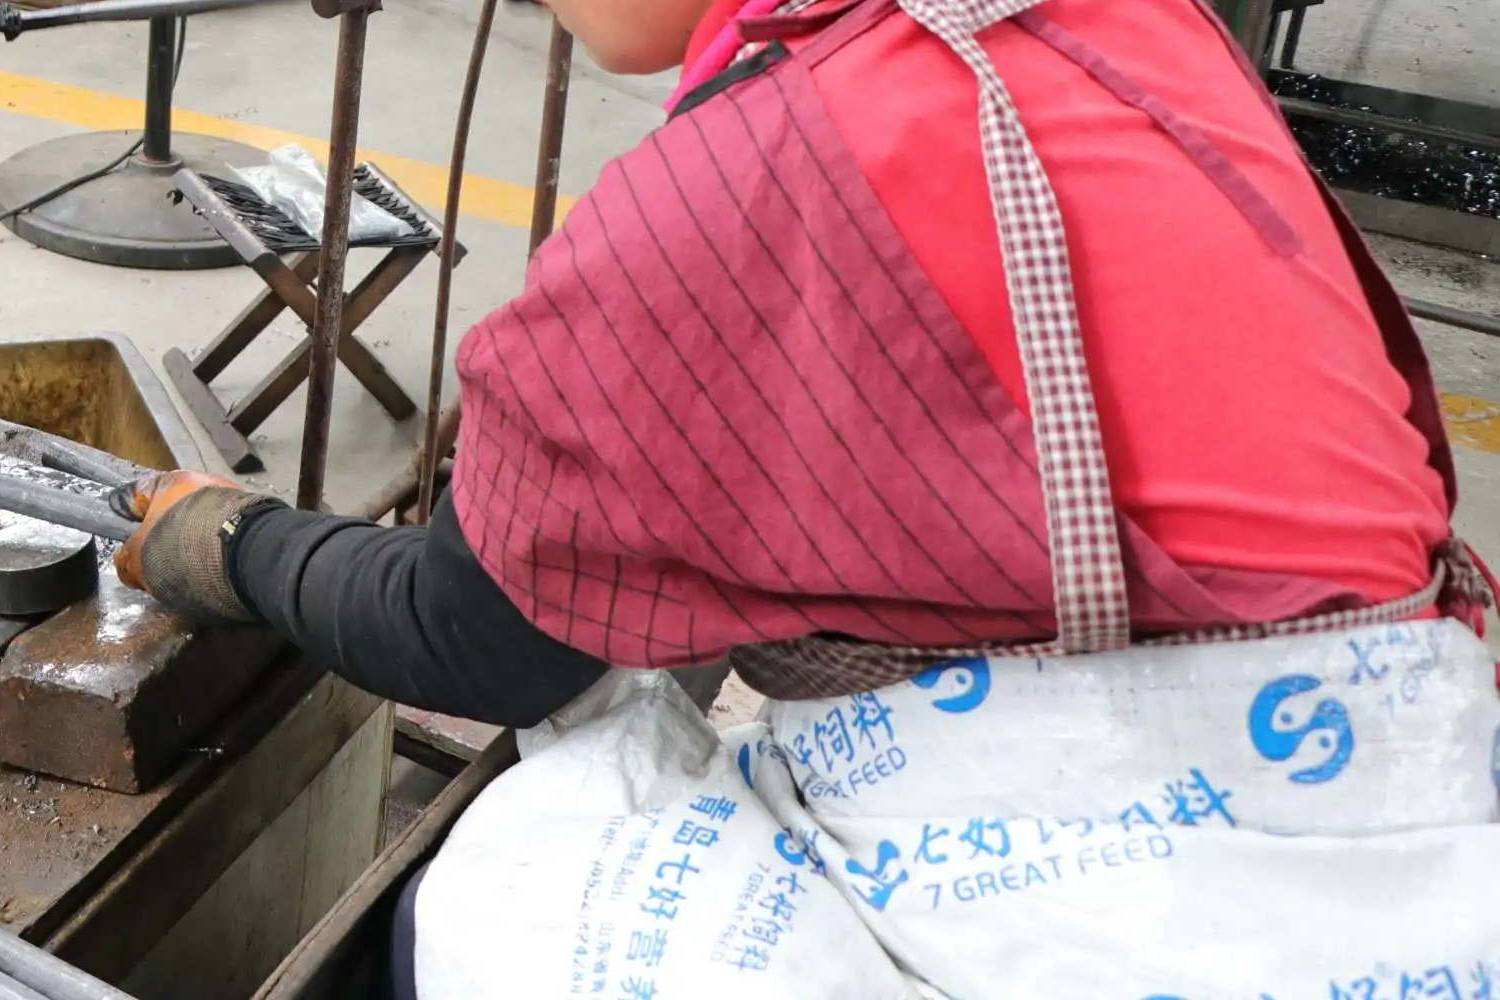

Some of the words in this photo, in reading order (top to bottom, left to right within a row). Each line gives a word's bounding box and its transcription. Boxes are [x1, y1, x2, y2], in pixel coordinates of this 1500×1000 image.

[848, 746, 908, 796] FEED
[923, 884, 942, 909] 7
[952, 855, 1065, 903] GREAT
[1077, 834, 1174, 875] FEED
